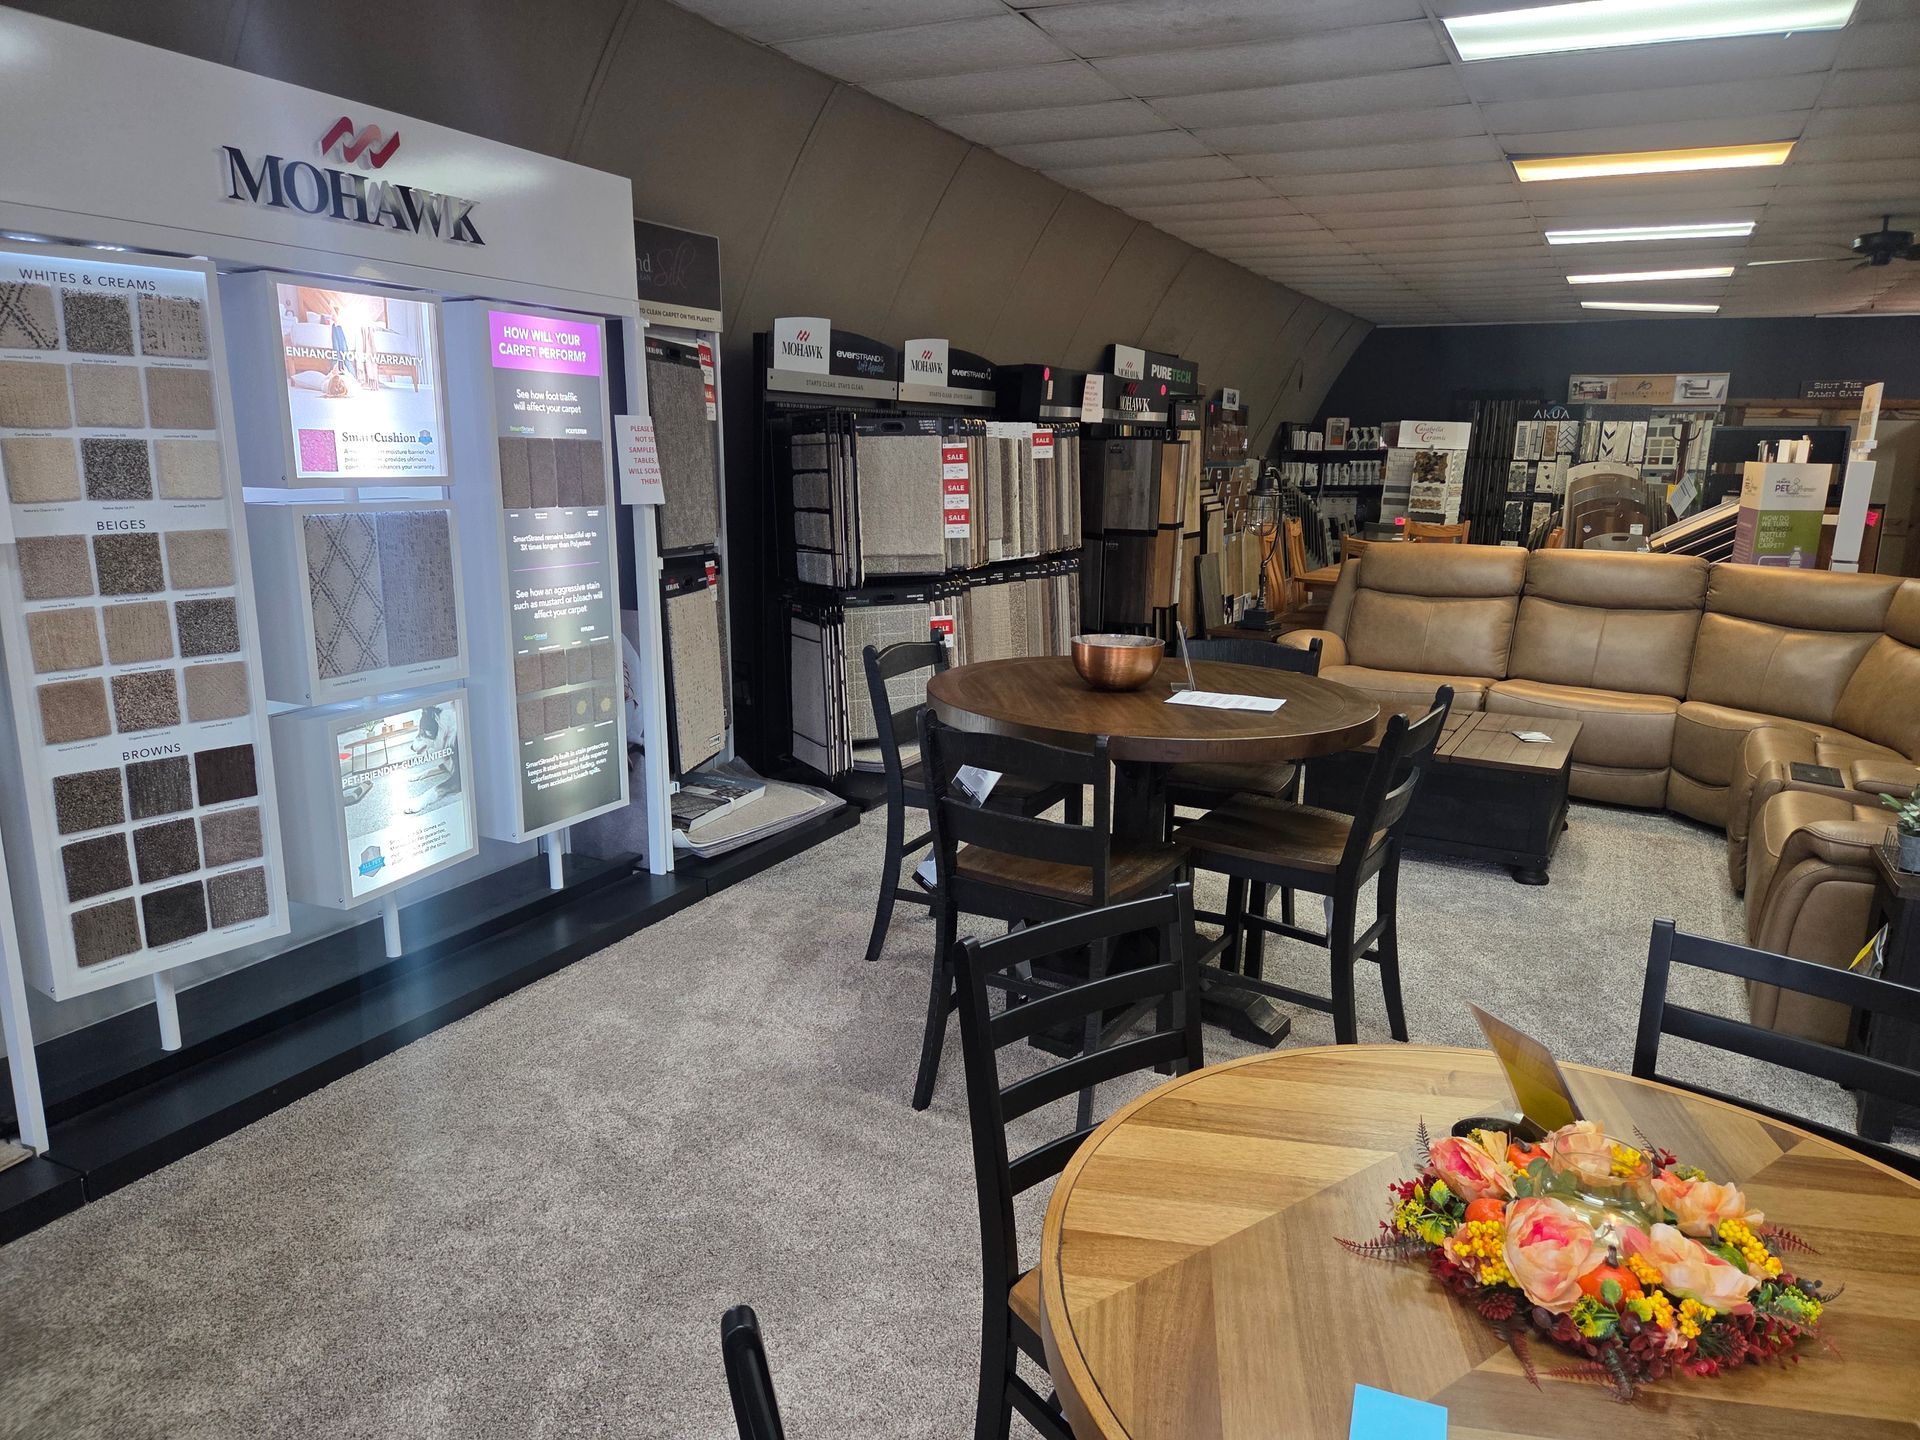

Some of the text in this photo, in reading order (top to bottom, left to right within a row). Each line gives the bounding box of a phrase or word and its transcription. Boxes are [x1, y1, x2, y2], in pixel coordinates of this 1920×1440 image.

[222, 145, 486, 246] MOHAWK
[18, 267, 157, 292] WHITES & CREAMS
[646, 308, 662, 316] CLEAN
[662, 310, 680, 319] CARPET
[503, 326, 580, 346] HOW WILL YOUR
[285, 346, 338, 360] ENHANCE
[371, 353, 424, 367] WARRANTY
[498, 342, 587, 363] CARPET PERFORM?
[700, 353, 711, 362] SALE
[782, 341, 823, 360] MOHAWK
[911, 359, 943, 374] MOHAWK
[1151, 363, 1192, 383] PURETECH
[806, 379, 822, 388] STARTS
[516, 388, 578, 402] See how foot traffic
[1119, 395, 1150, 412] MOHAWK
[513, 401, 582, 415] will affect your carpet
[948, 484, 965, 492] SALE
[1774, 484, 1790, 492] PET
[96, 519, 146, 531] BEIGES
[513, 533, 544, 543] SmartStrand
[563, 531, 584, 539] beautiful
[542, 542, 559, 550] longer
[515, 589, 529, 599] See
[529, 588, 544, 597] how
[553, 583, 586, 596] aggressive
[586, 581, 600, 590] stain
[513, 601, 530, 611] such
[530, 601, 538, 609] as
[538, 596, 565, 607] mustard
[572, 592, 593, 603] bleach
[593, 590, 603, 600] will
[534, 605, 588, 619] affect your carpet
[122, 743, 181, 762] BROWNS
[575, 747, 586, 756] stain
[586, 741, 609, 753] protection
[527, 768, 543, 777] keeps
[569, 756, 579, 765] and
[590, 749, 608, 760] superior
[530, 770, 562, 785] colorfastness
[595, 757, 607, 765] even
[536, 782, 550, 791] from
[549, 774, 573, 787] accidental
[573, 769, 589, 780] bleach
